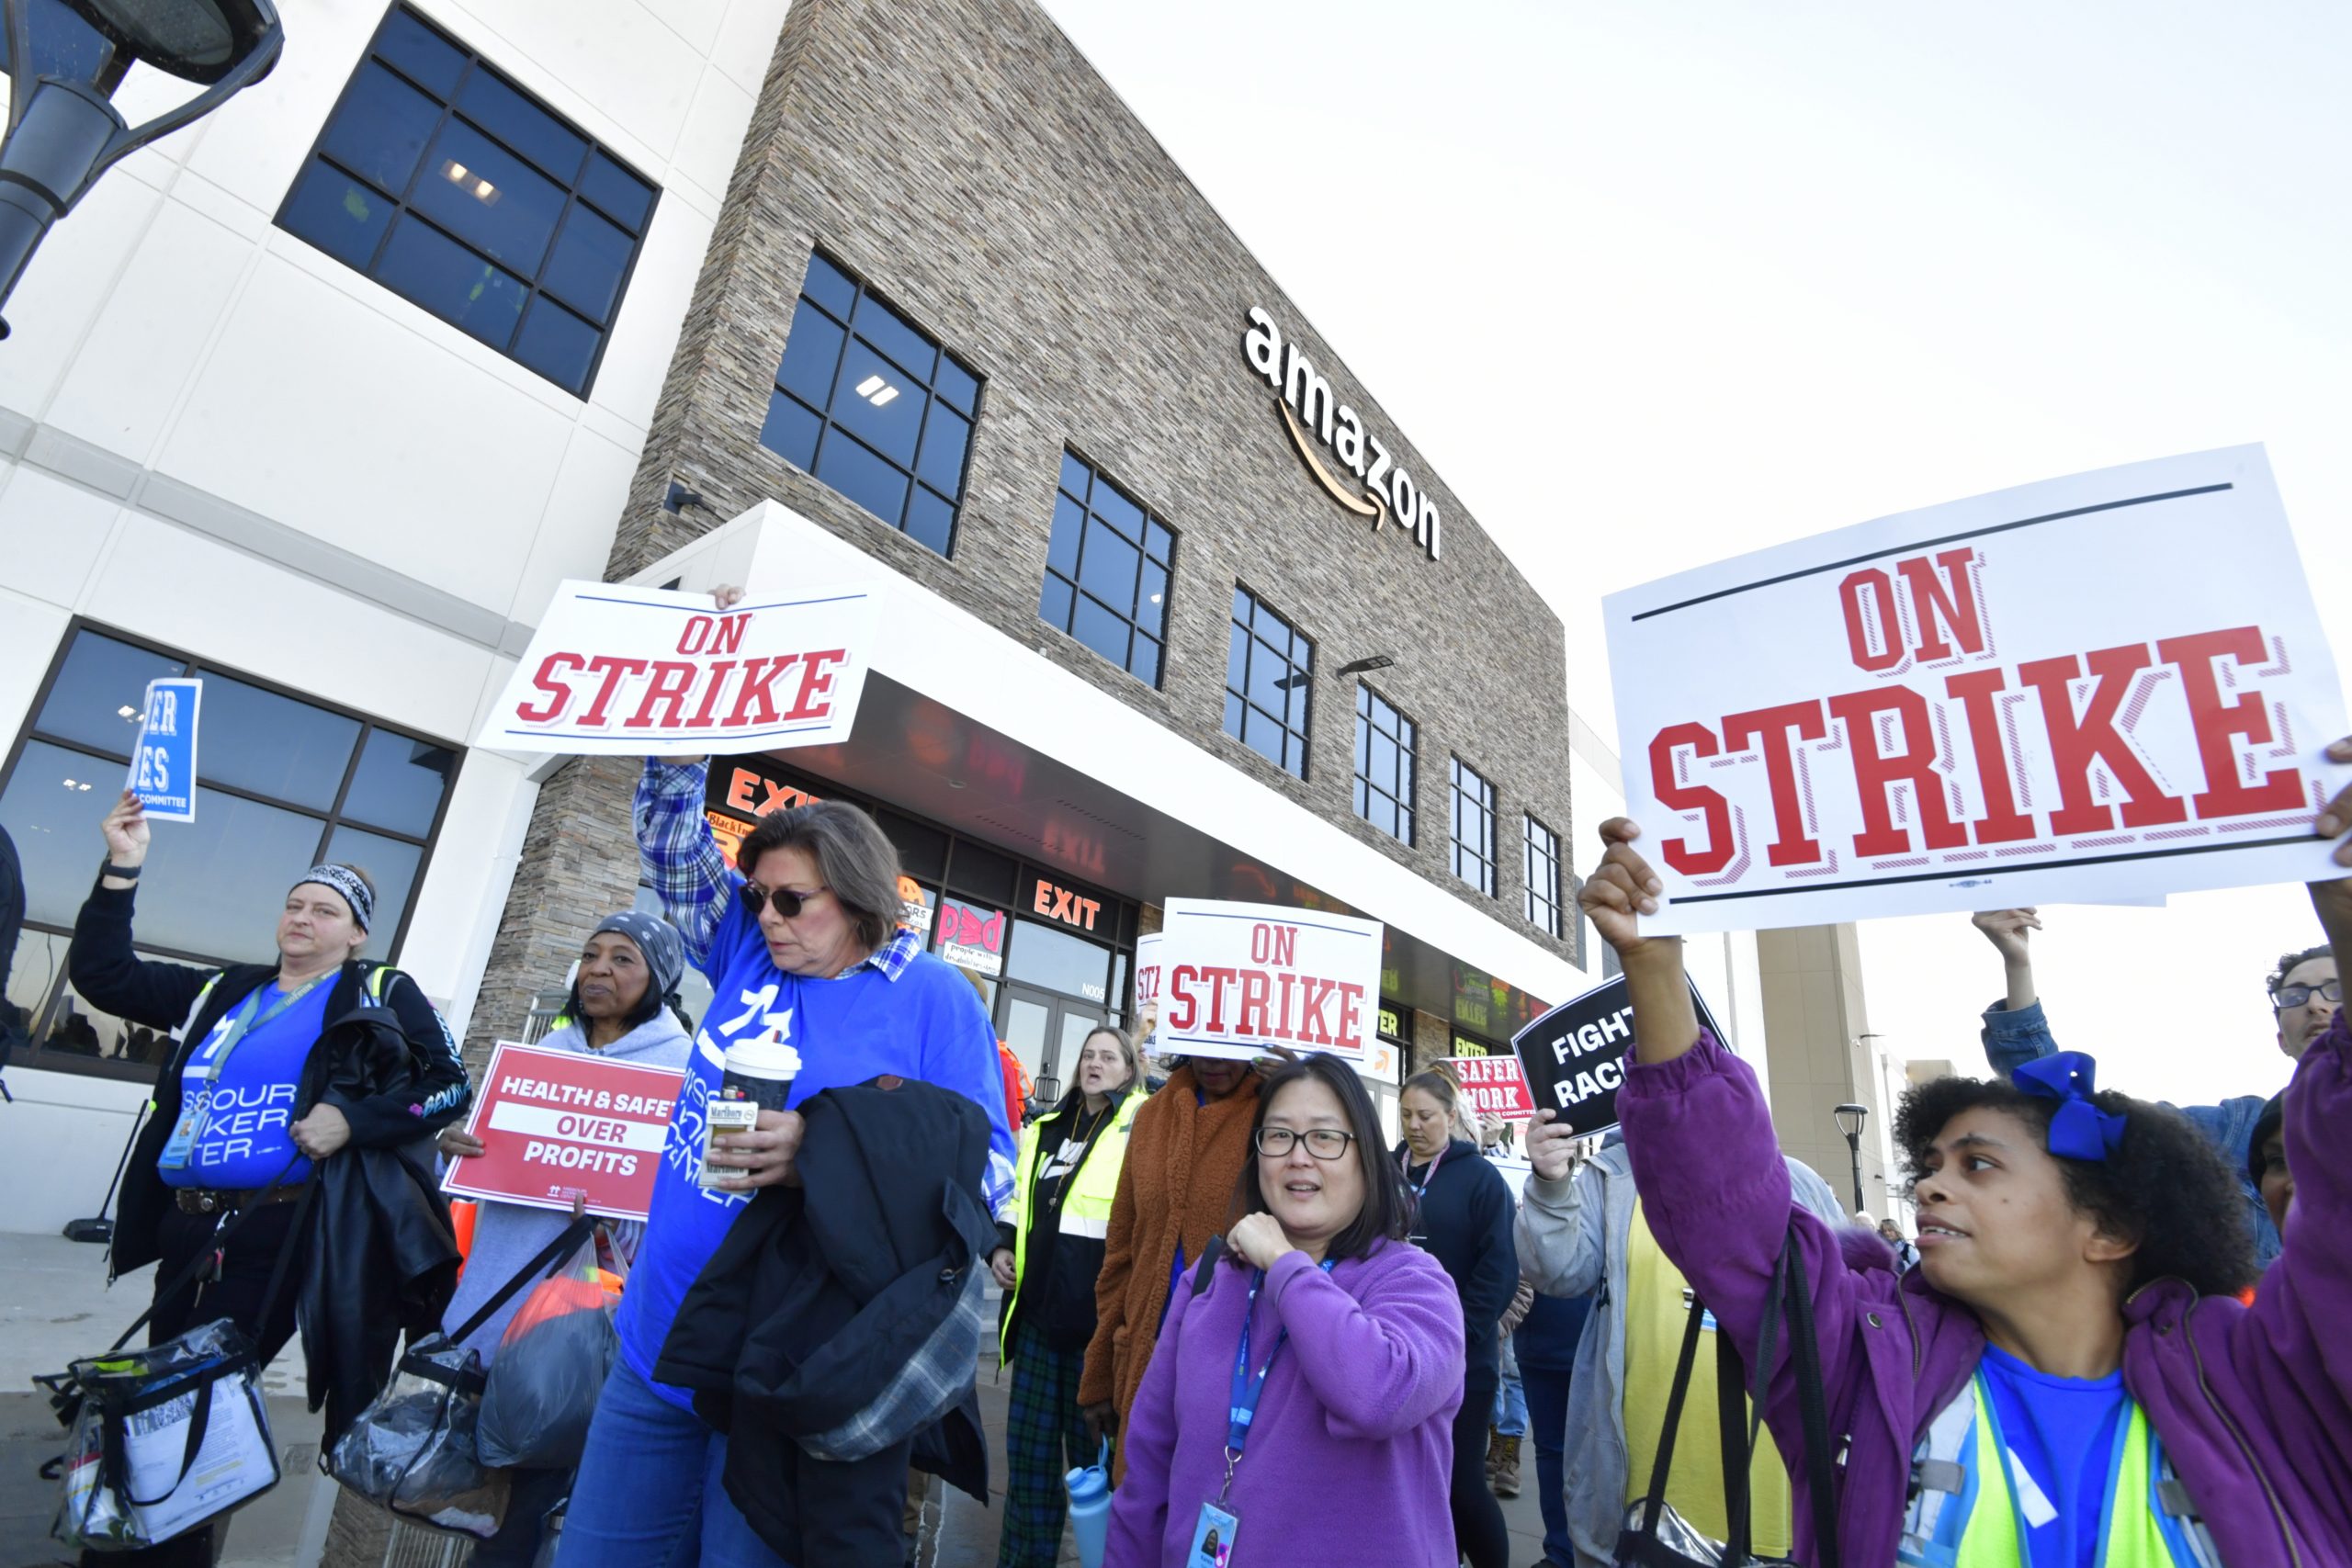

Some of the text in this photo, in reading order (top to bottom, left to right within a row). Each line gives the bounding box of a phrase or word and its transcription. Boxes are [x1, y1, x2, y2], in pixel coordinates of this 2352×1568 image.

[1244, 306, 1441, 561] amazon
[1838, 546, 1987, 677] ON
[675, 613, 754, 656] ON
[515, 649, 849, 728] STRIKE
[1648, 626, 2325, 886] STRIKE
[139, 793, 187, 808] COMMITTEE
[1034, 879, 1101, 931] EXIT
[1250, 923, 1299, 968] ON
[1169, 964, 1366, 1053] STRIKE
[1457, 1059, 1521, 1083] SAFER
[501, 1076, 676, 1118] HEALTH & SAFE
[556, 1115, 628, 1144] OVER
[523, 1141, 639, 1177] PROFITS
